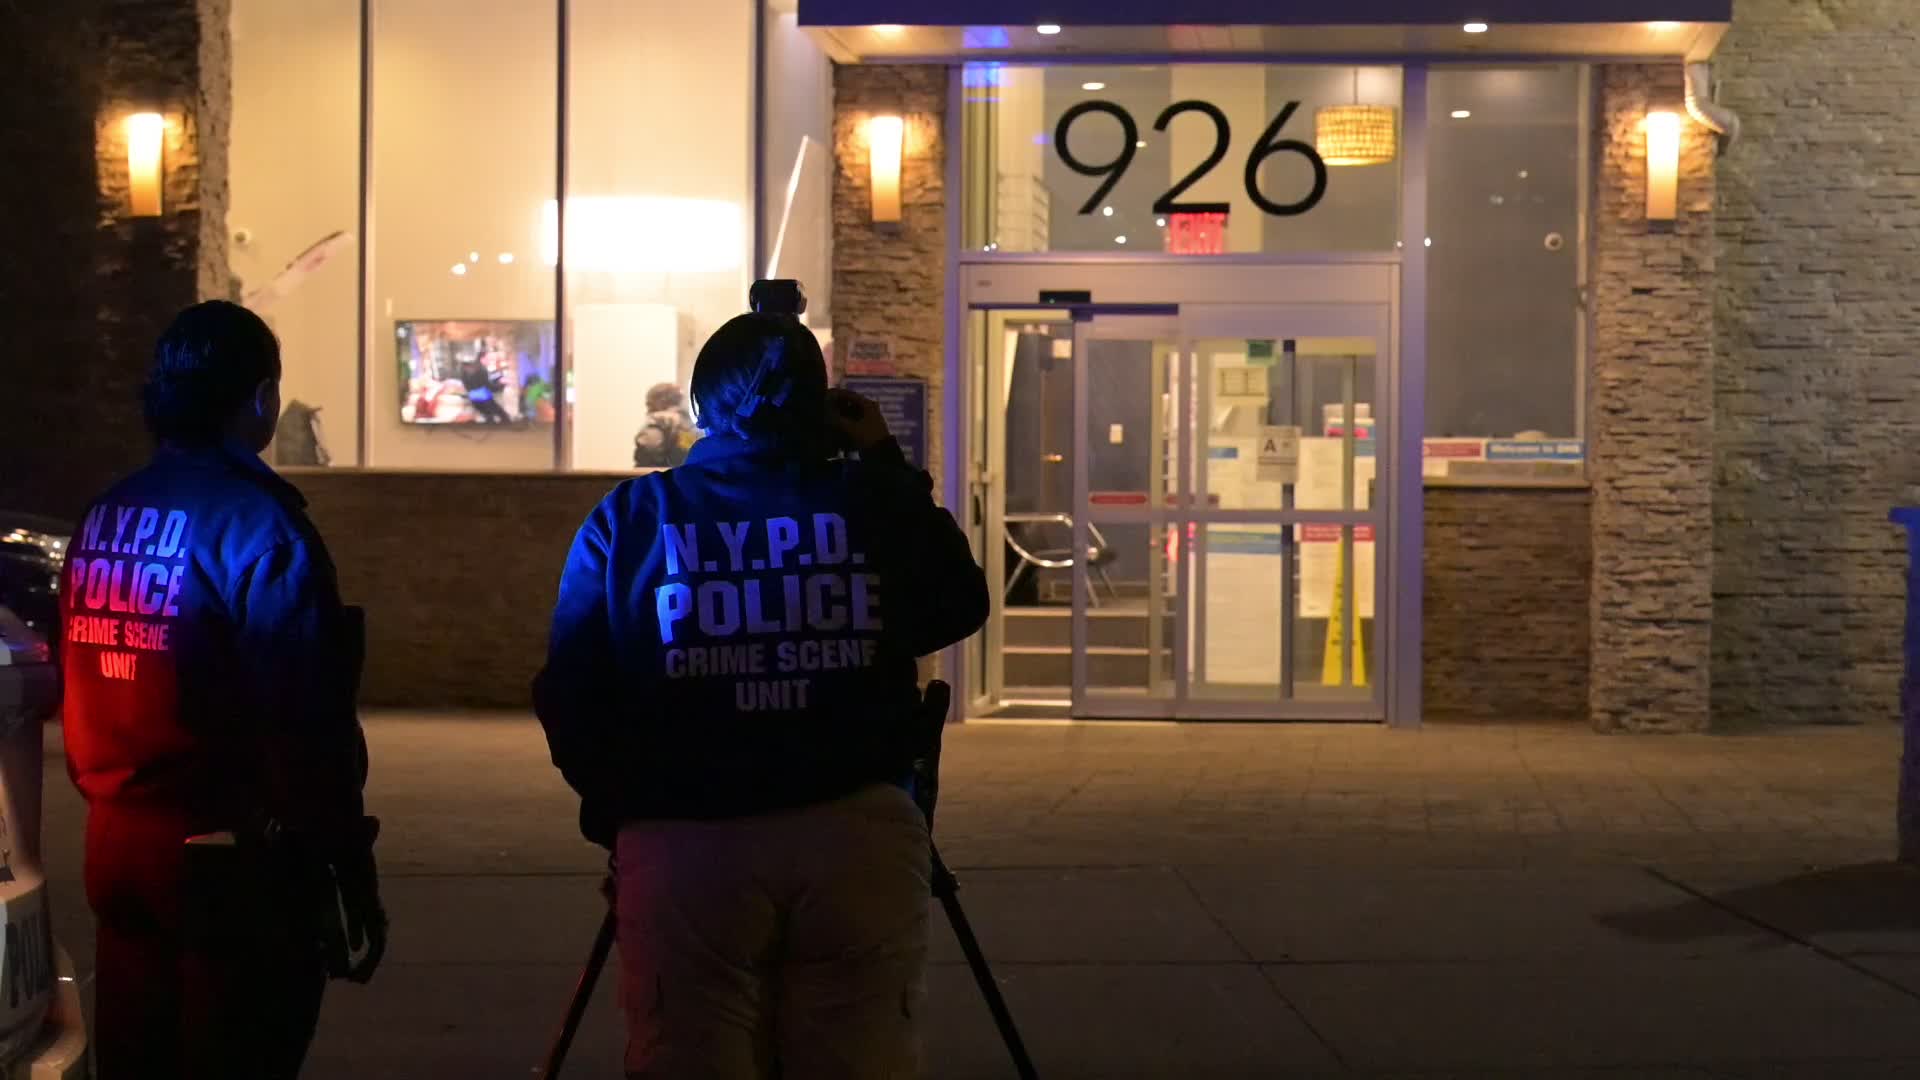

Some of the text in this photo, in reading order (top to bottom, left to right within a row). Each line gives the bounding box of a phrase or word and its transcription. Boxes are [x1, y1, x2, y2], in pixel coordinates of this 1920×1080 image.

[1054, 100, 1327, 216] 926
[81, 504, 187, 559] N.Y.P.D.
[662, 513, 865, 576] N.Y.P.D.
[70, 557, 185, 617] POLICE
[654, 572, 883, 645] POLICE
[665, 643, 766, 679] CRIME
[735, 679, 810, 712] UNIT
